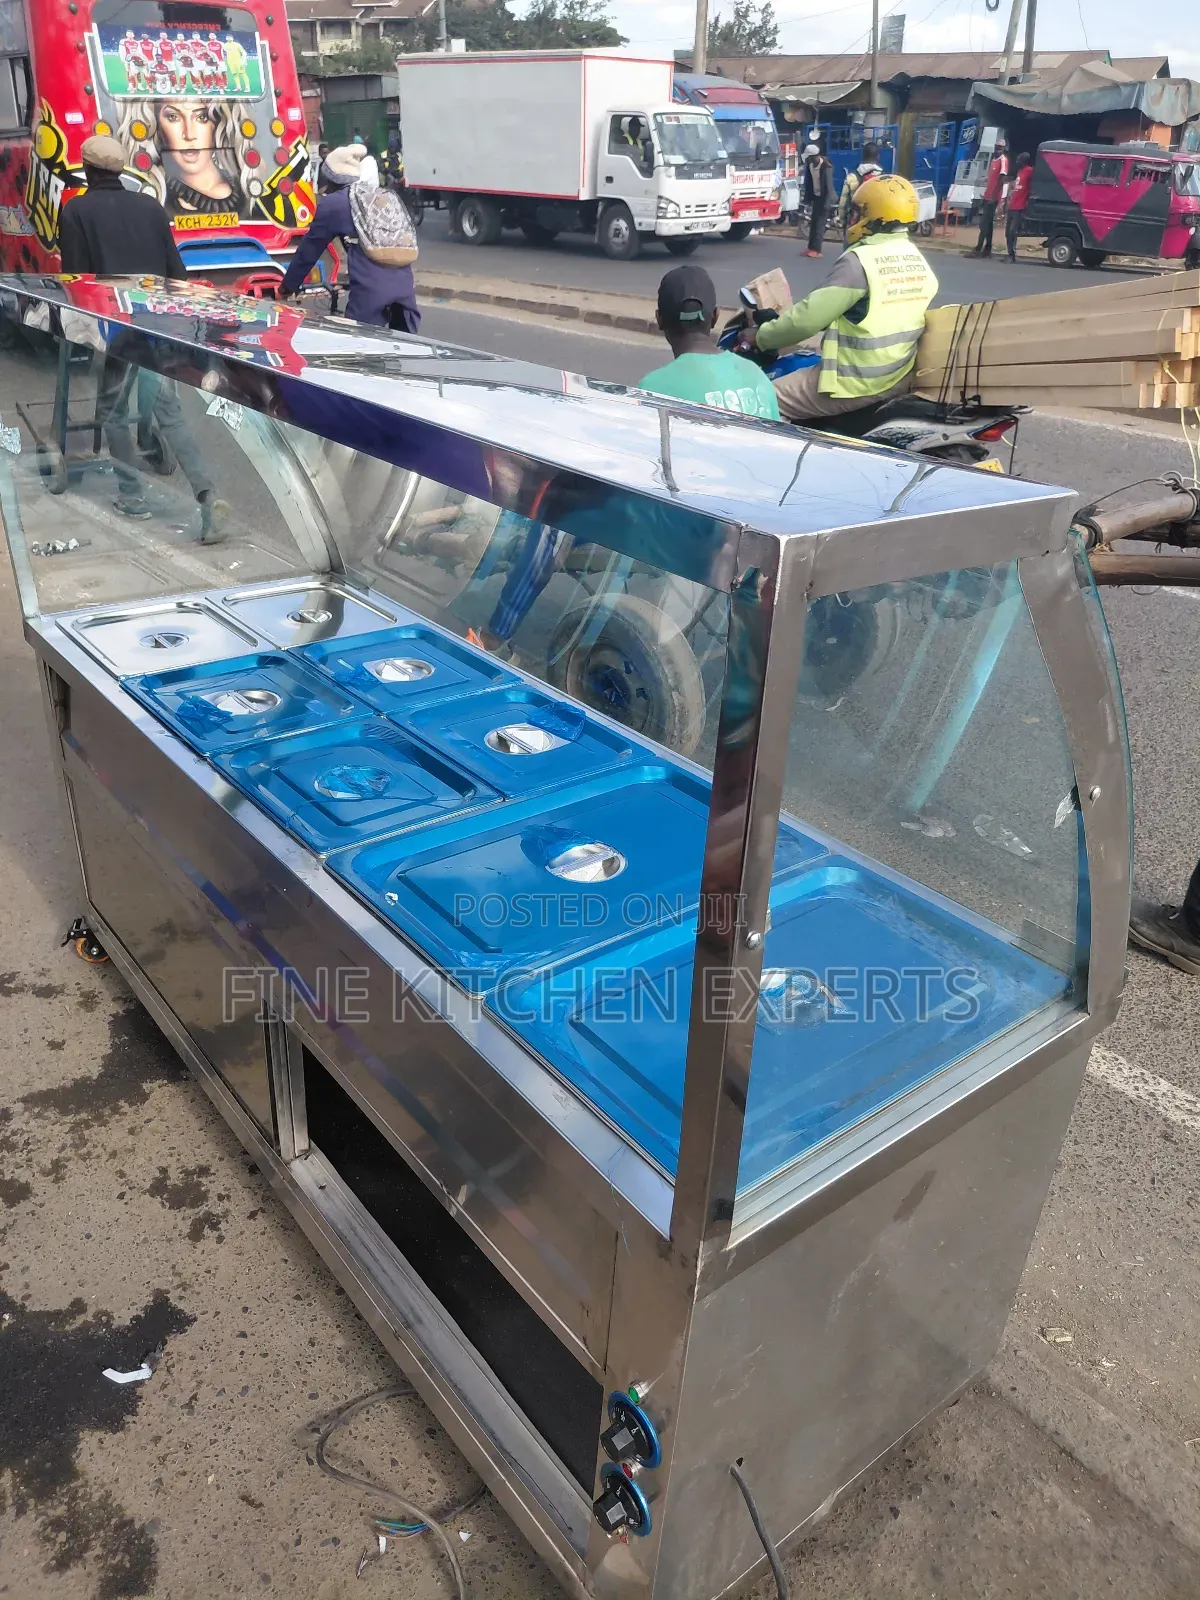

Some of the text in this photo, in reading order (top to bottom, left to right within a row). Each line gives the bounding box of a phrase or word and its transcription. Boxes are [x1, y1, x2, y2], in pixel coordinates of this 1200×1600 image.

[177, 214, 238, 229] KCH 232K
[874, 255, 900, 265] FAMILY
[878, 265, 905, 275] MEDICAL
